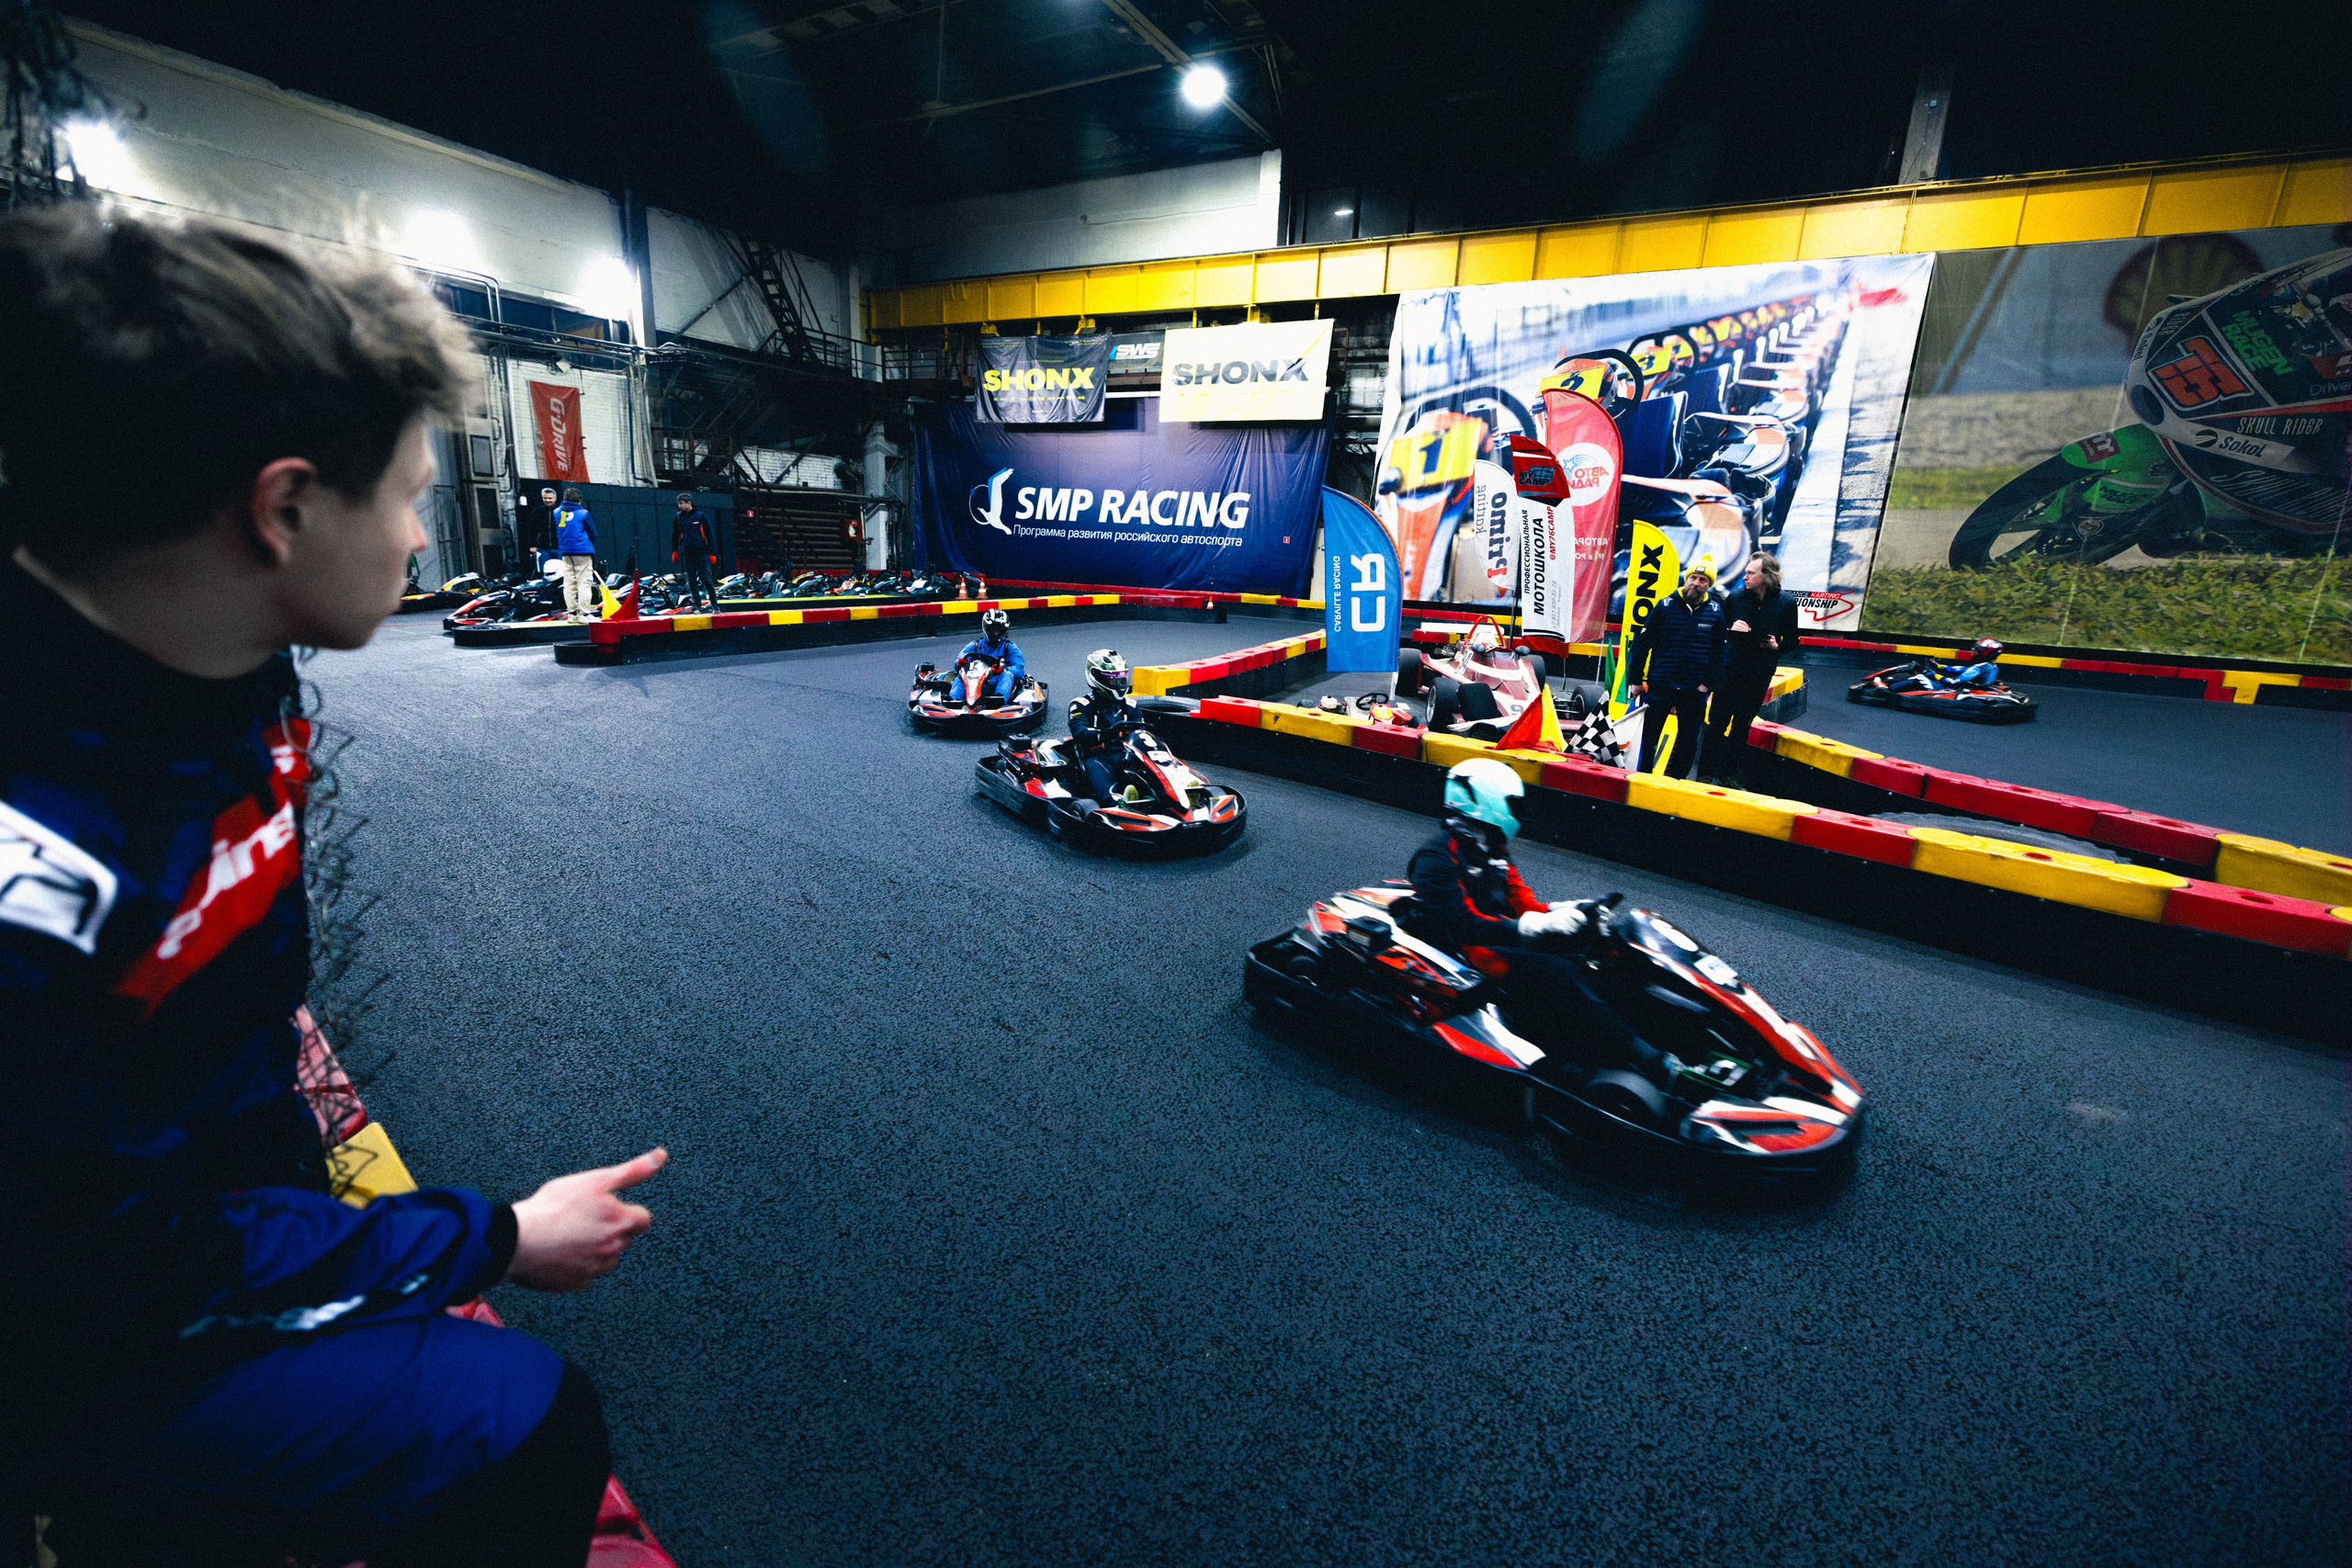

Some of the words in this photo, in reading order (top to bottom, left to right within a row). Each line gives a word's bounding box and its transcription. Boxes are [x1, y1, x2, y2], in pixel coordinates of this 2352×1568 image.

[2222, 322, 2268, 371] RACE
[1171, 357, 1309, 386] SHONX
[1637, 355, 1656, 371] 3
[983, 367, 1095, 391] SHONX
[2236, 417, 2277, 434] SKULL
[1418, 438, 1444, 475] 1
[1519, 478, 1549, 486] CAMP
[1015, 487, 1093, 522] SMP
[1099, 489, 1251, 529] RACING
[1013, 525, 1066, 537] Программа
[1068, 528, 1113, 540] развития
[1114, 530, 1179, 544] российского
[1181, 535, 1243, 548] автоспорта
[1546, 506, 1556, 561] @MY76CAMP
[1532, 517, 1545, 615] МОТОШКОЛА
[1628, 543, 1664, 649] ONX
[1138, 732, 1158, 748] 3
